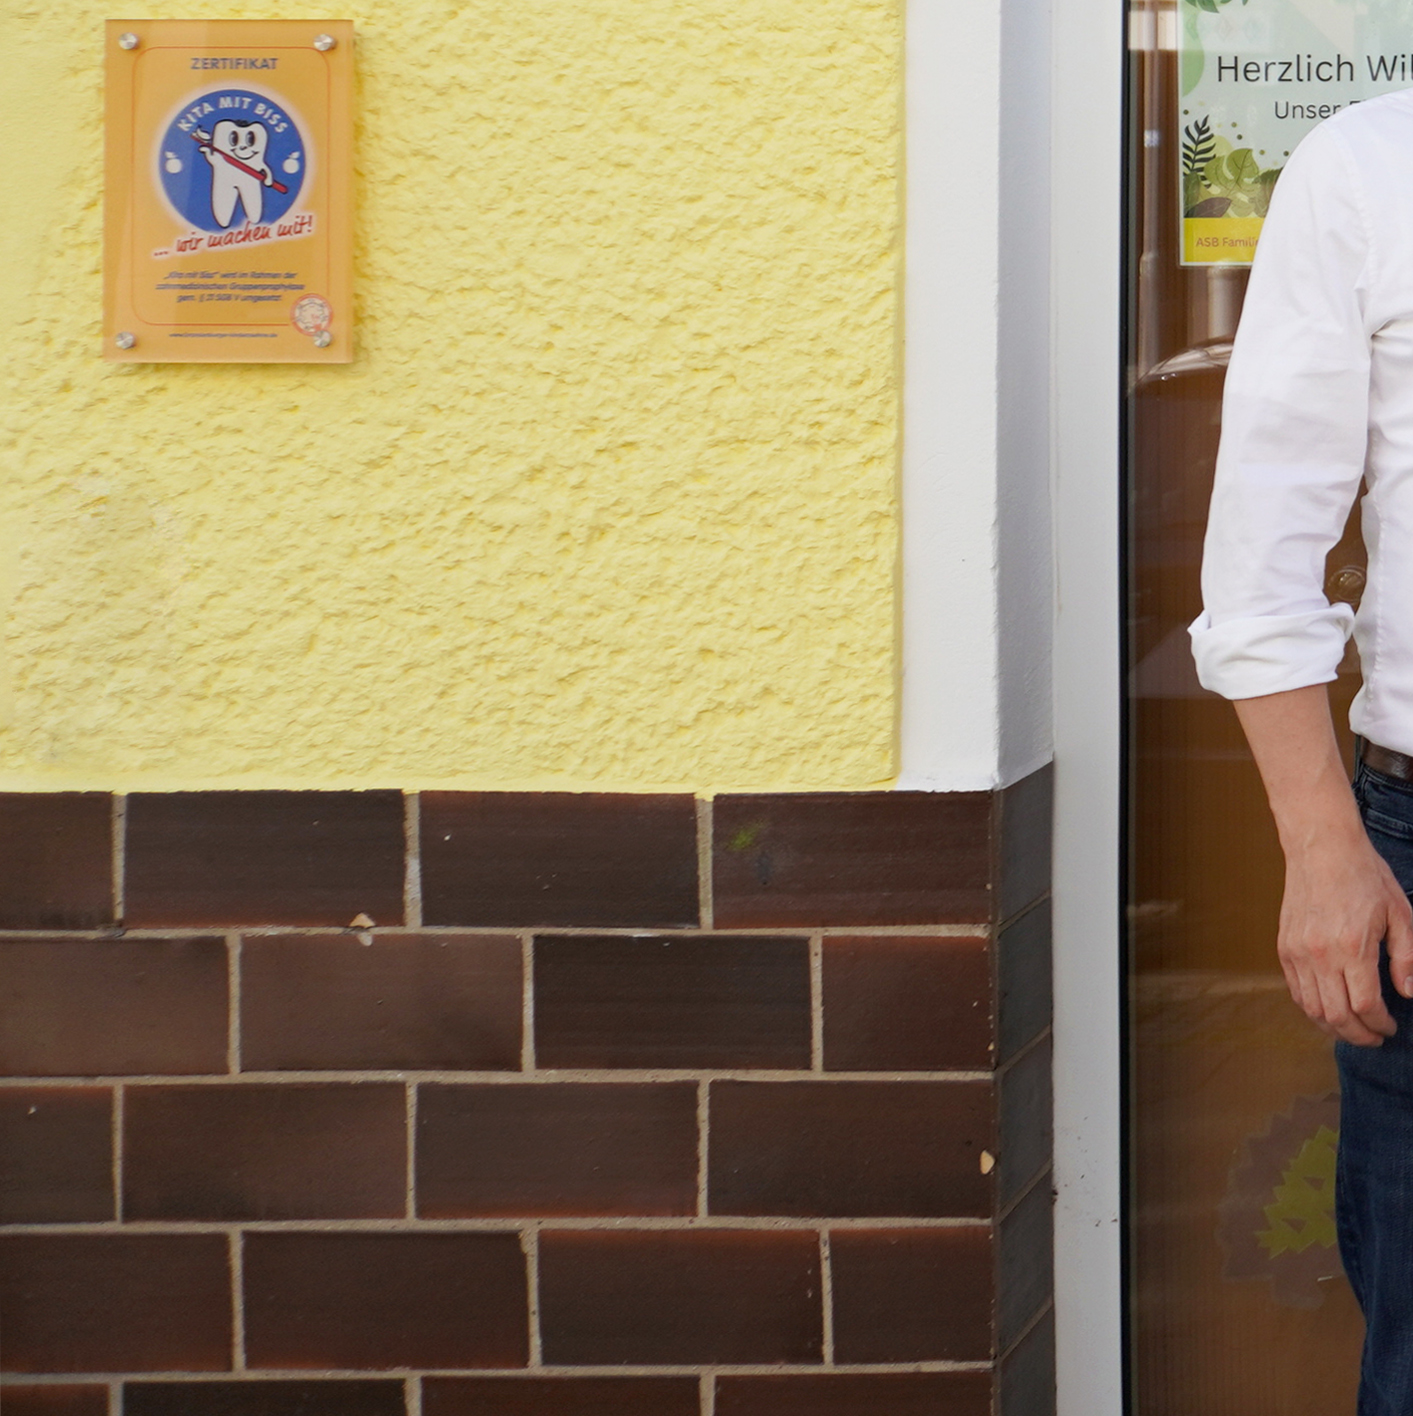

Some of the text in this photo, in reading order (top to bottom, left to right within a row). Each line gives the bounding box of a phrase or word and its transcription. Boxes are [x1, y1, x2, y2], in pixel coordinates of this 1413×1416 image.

[190, 57, 278, 70] ZERTIFIKAT
[1216, 53, 1355, 82] Herzlich
[177, 96, 288, 133] KITA MIT BISS
[1274, 100, 1342, 120] Unser
[176, 231, 204, 252] wir
[207, 220, 272, 248] machen
[277, 215, 313, 237] mit!
[1195, 237, 1219, 247] ASB
